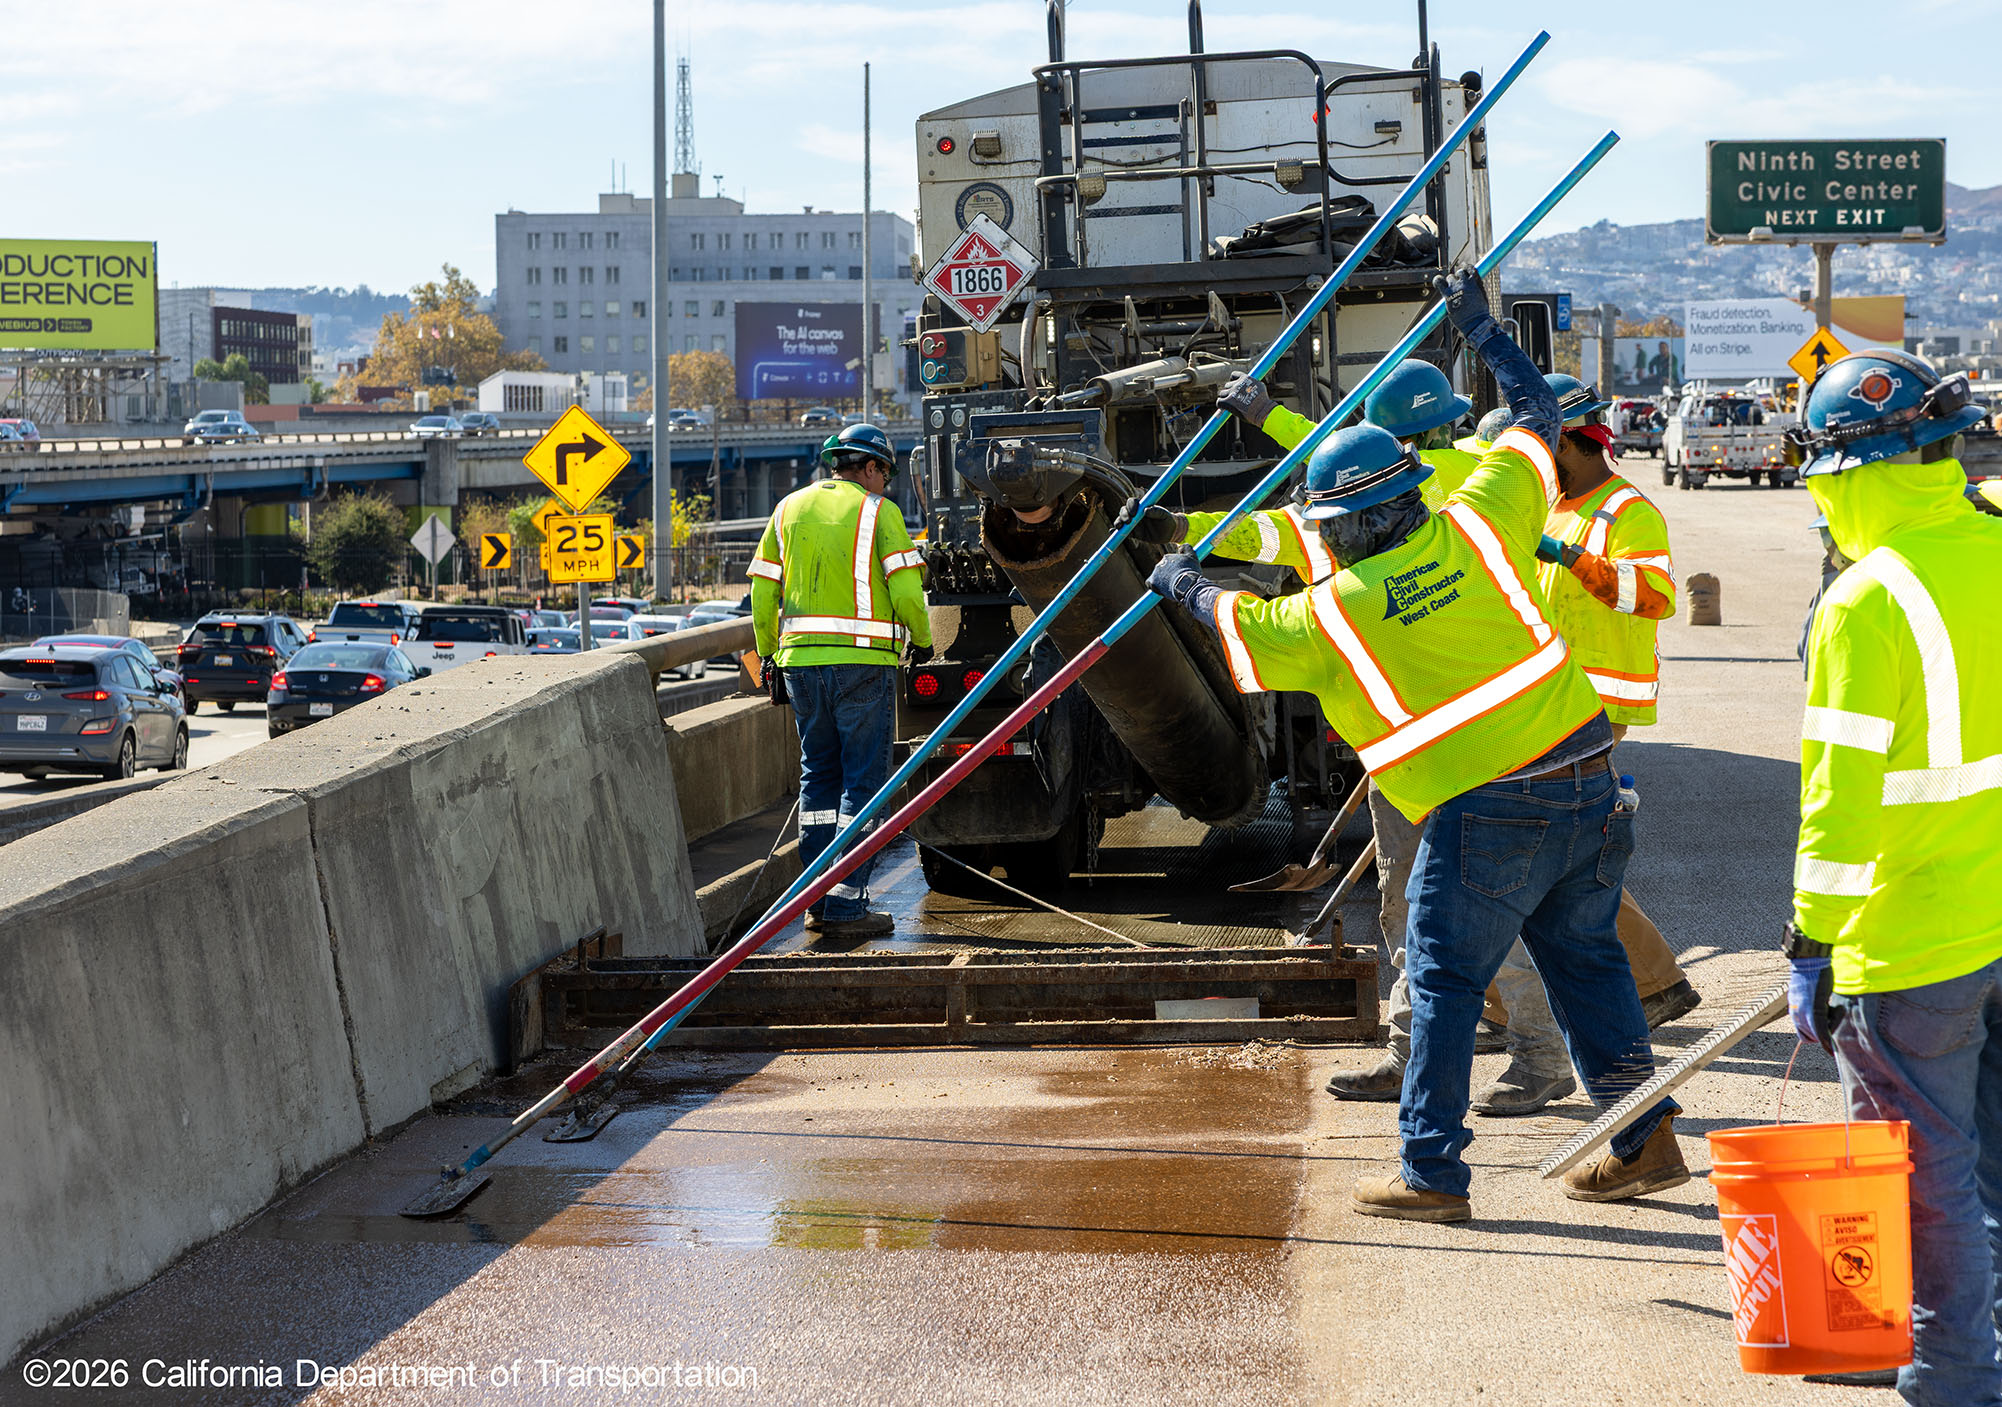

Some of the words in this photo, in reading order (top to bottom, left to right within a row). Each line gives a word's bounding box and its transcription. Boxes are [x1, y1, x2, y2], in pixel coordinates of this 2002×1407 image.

[1738, 151, 1815, 171] Ninth
[1834, 150, 1921, 170] Street
[1737, 181, 1807, 201] Civic
[1825, 181, 1918, 201] Center
[1765, 209, 1818, 225] NEXT
[1836, 209, 1885, 225] EXIT
[0, 254, 147, 278] DUCTION
[954, 267, 1003, 293] 1866
[1, 282, 134, 305] ERENCE
[976, 304, 985, 317] 3
[1690, 307, 1719, 320] Fraud
[1721, 306, 1772, 319] detection.
[776, 325, 796, 340] The
[797, 326, 807, 340] AI
[808, 329, 844, 340] canvas
[1690, 322, 1758, 335] Monetization.
[1760, 321, 1805, 336] Banking.
[783, 341, 797, 355] for
[799, 342, 816, 355] the
[817, 341, 838, 355] web
[1690, 343, 1703, 354] All
[1704, 346, 1718, 354] on
[1720, 343, 1752, 356] Stripe.
[556, 525, 604, 552] 25
[564, 560, 600, 572] MPH
[1386, 560, 1440, 591] American
[1391, 579, 1420, 600] Civil
[1396, 569, 1465, 611] Constructors
[1399, 605, 1430, 627] West
[1429, 588, 1461, 611] Coast
[432, 651, 455, 661] Jeep
[1833, 1214, 1869, 1225] WARNING
[1835, 1226, 1858, 1234] AVISO
[1736, 1264, 1781, 1343] DEPOT
